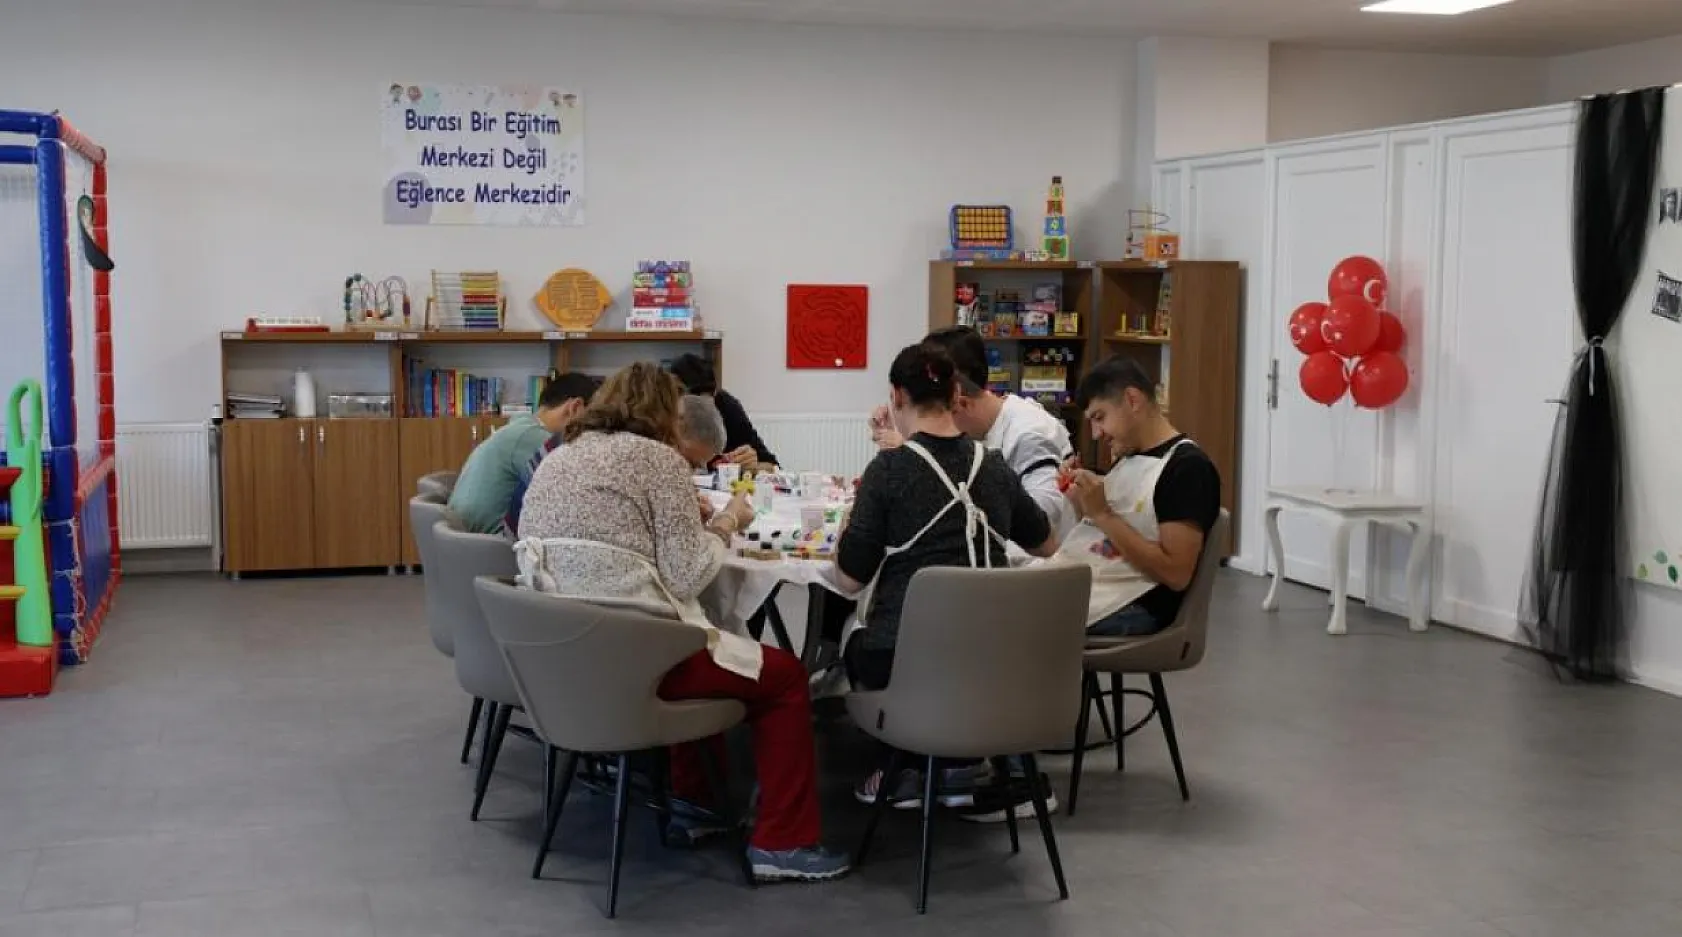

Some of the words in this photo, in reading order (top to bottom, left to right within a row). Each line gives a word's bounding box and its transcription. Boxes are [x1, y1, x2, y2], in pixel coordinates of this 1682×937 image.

[406, 109, 462, 131] Burası
[471, 111, 497, 131] Bir
[505, 112, 561, 138] Eğitim
[421, 146, 494, 168] Merkezi
[503, 148, 547, 174] Değil
[396, 180, 466, 208] Eğlence
[474, 183, 571, 204] Merkezidir
